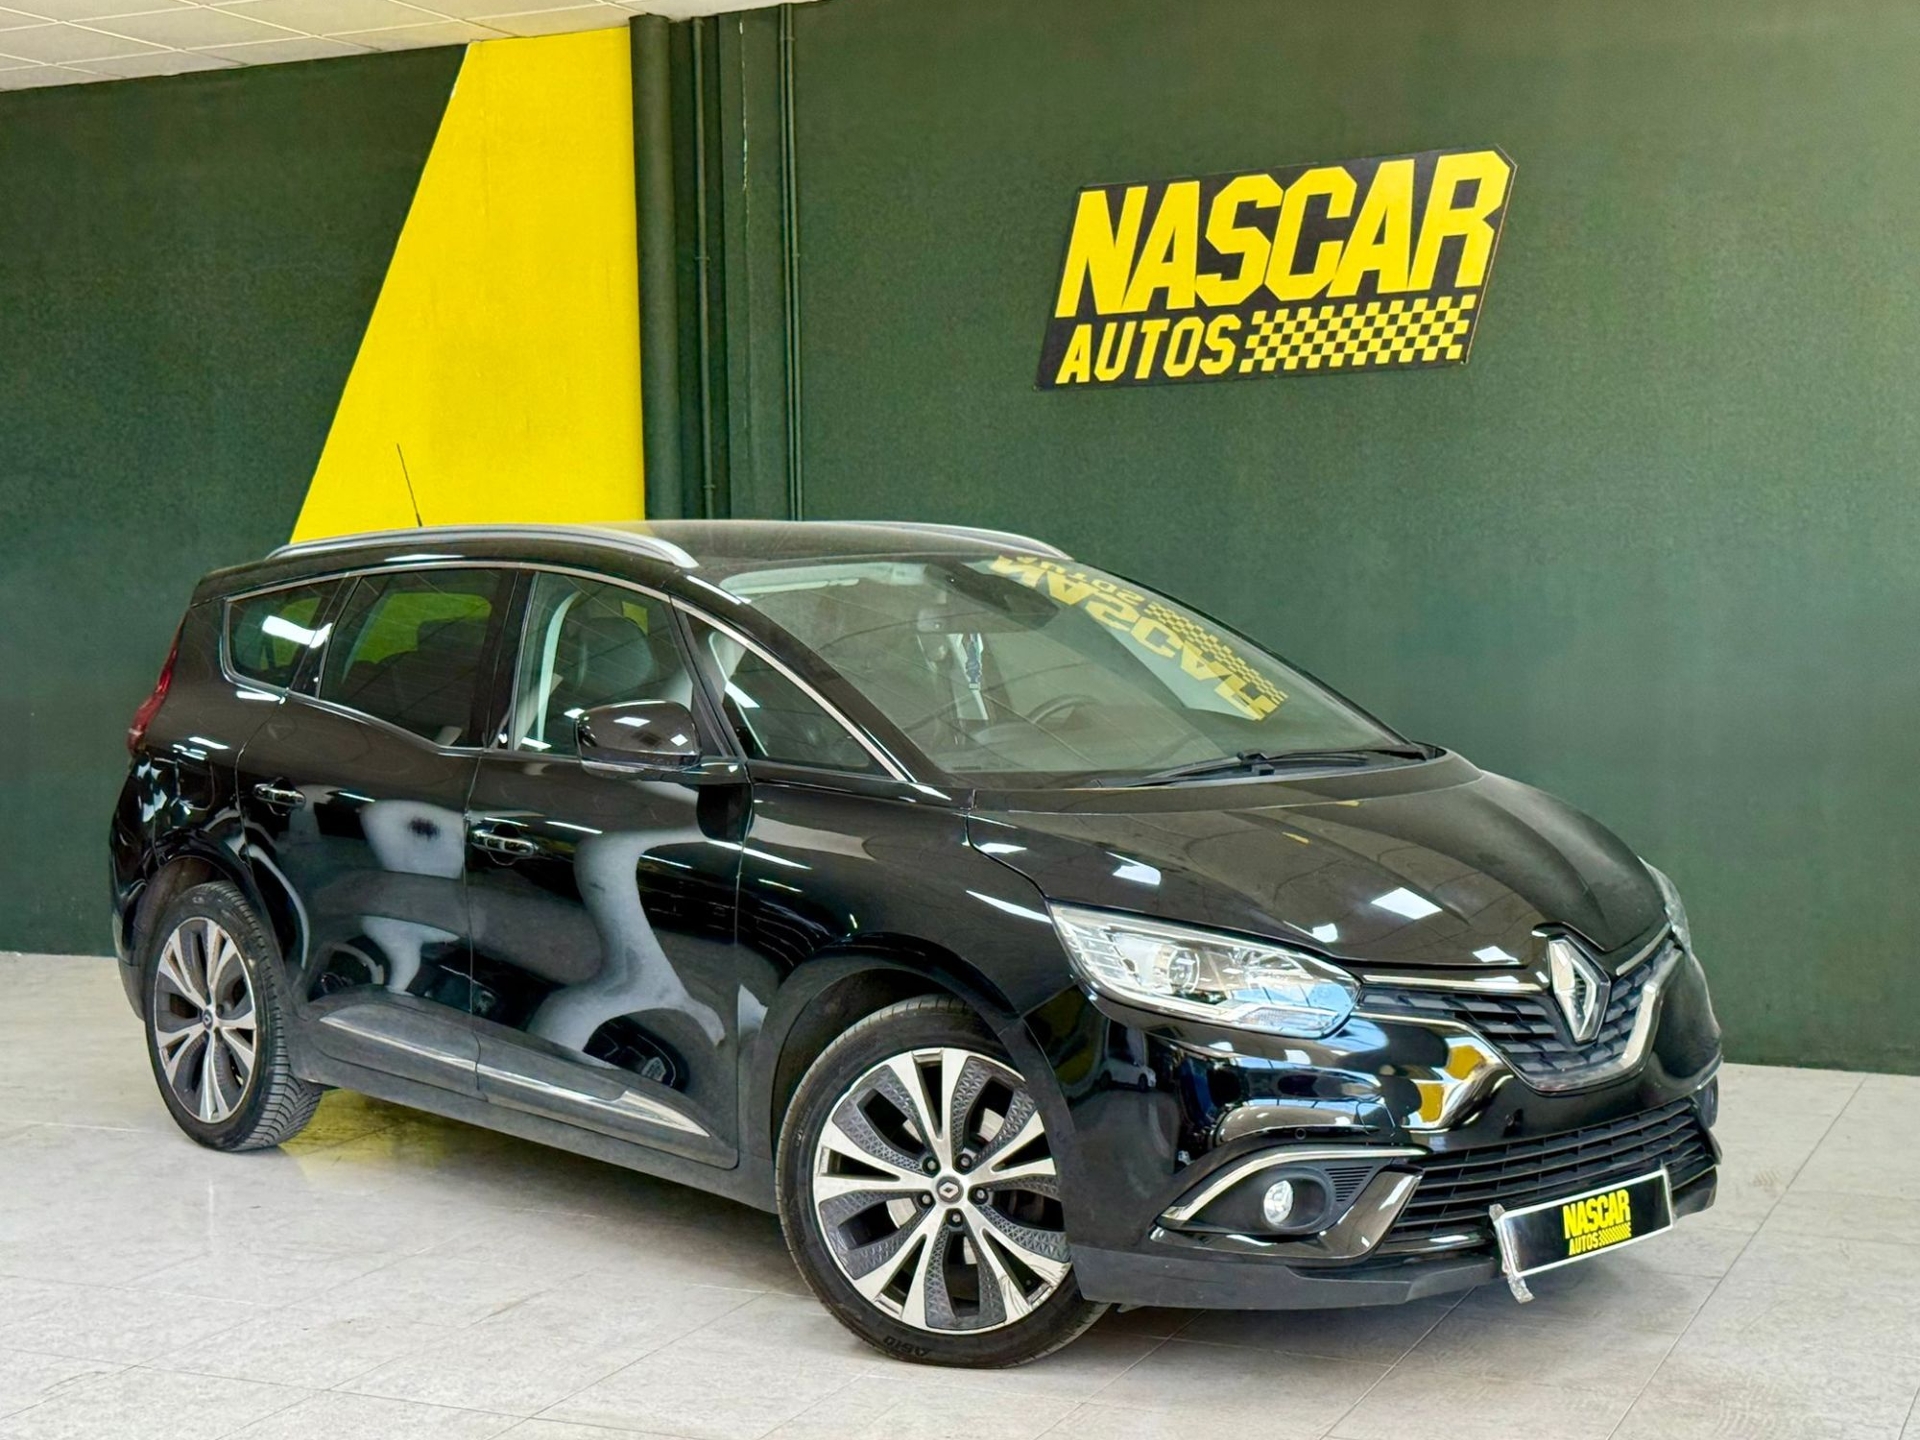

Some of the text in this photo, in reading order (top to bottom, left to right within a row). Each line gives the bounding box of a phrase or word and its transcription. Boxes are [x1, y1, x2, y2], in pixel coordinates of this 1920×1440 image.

[1054, 150, 1510, 318] NASCAR
[1055, 314, 1242, 384] AUTOS
[1562, 1189, 1631, 1239] NASCAR
[1569, 1231, 1599, 1256] AUTOS
